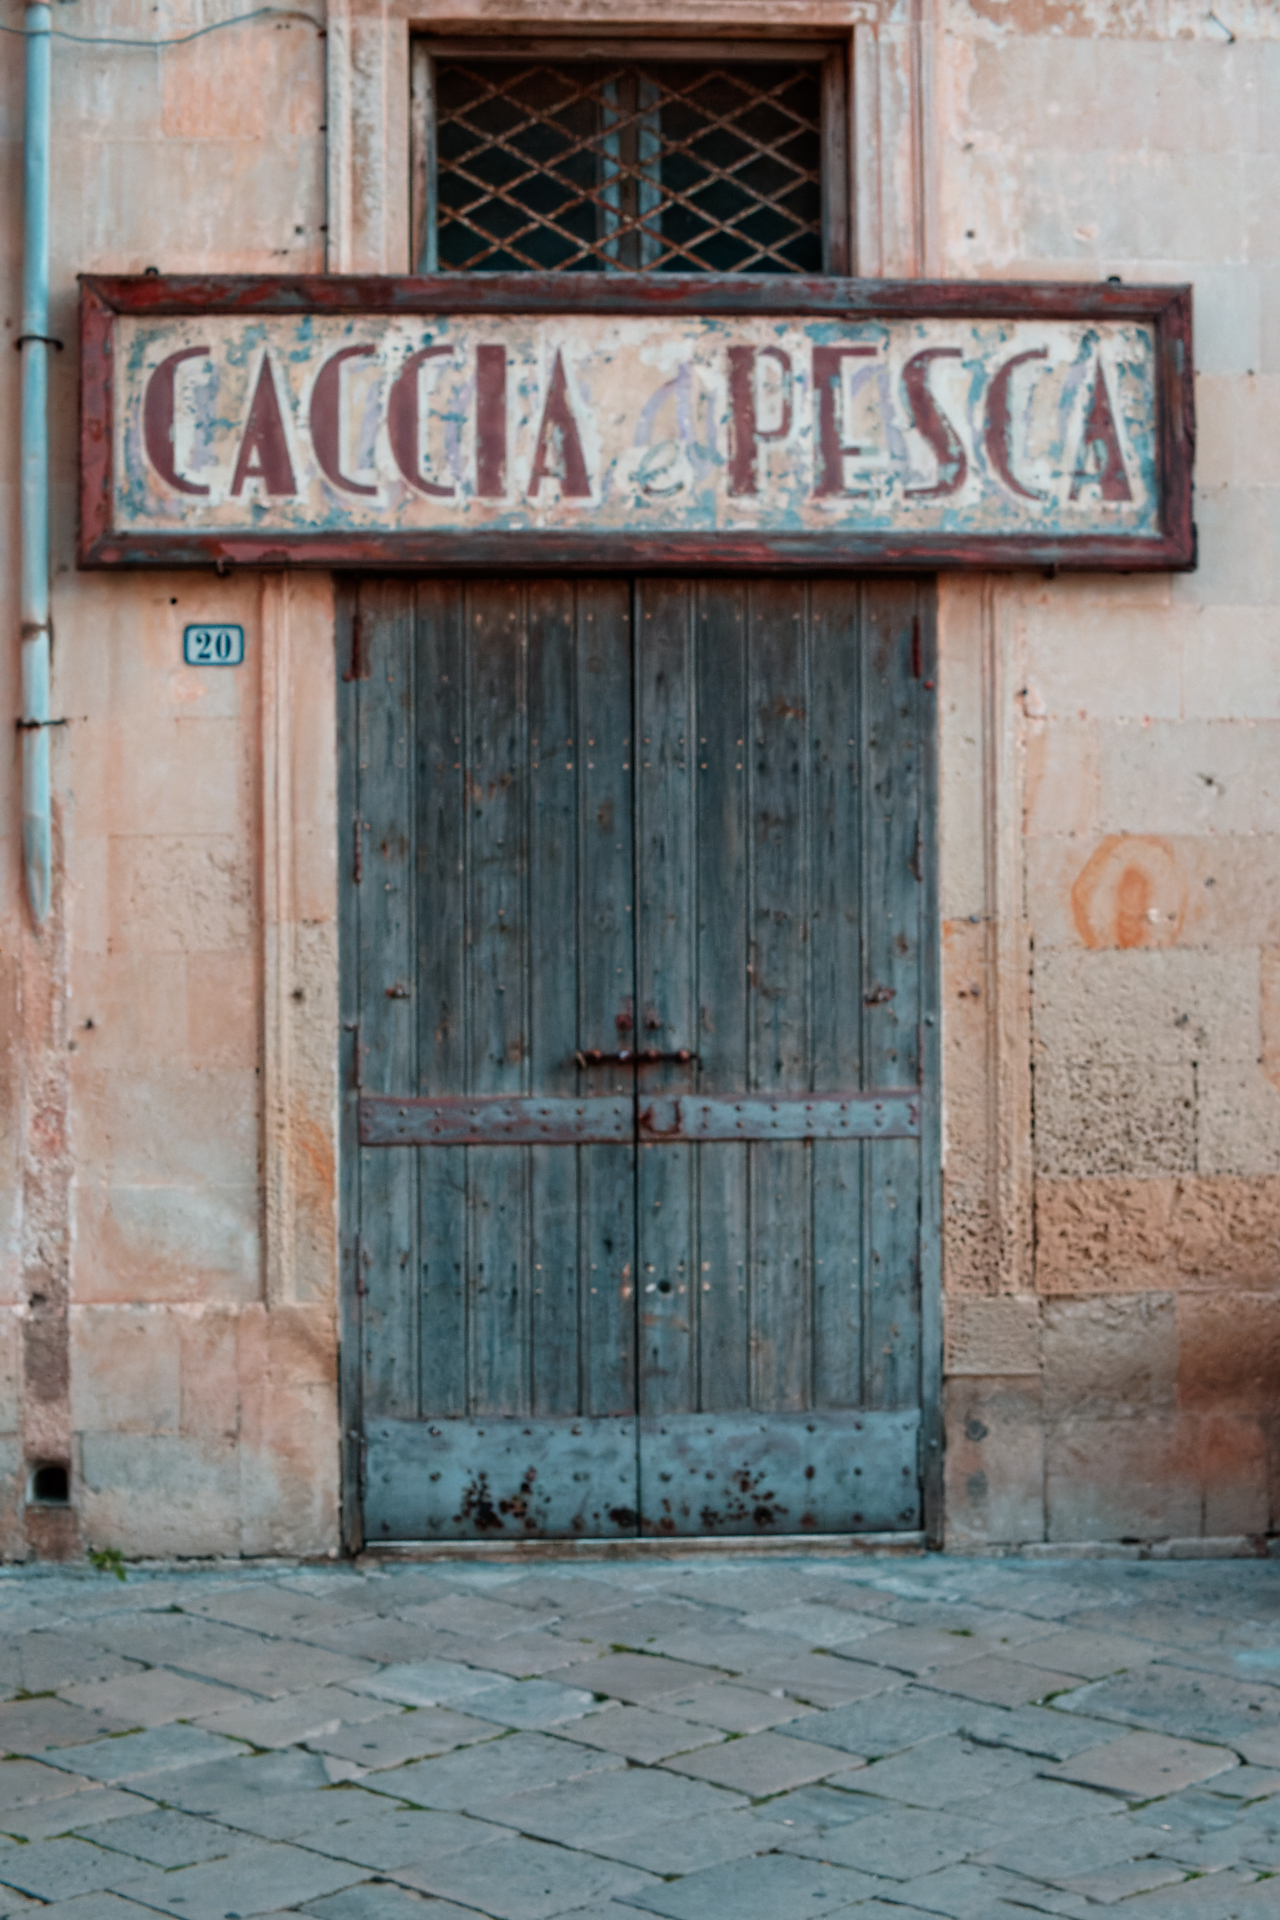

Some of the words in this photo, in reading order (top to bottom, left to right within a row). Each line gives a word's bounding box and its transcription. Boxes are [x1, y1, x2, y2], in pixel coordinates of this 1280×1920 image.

[143, 344, 592, 498] CACCIA
[725, 344, 1134, 502] PESCA
[196, 630, 232, 661] 20
